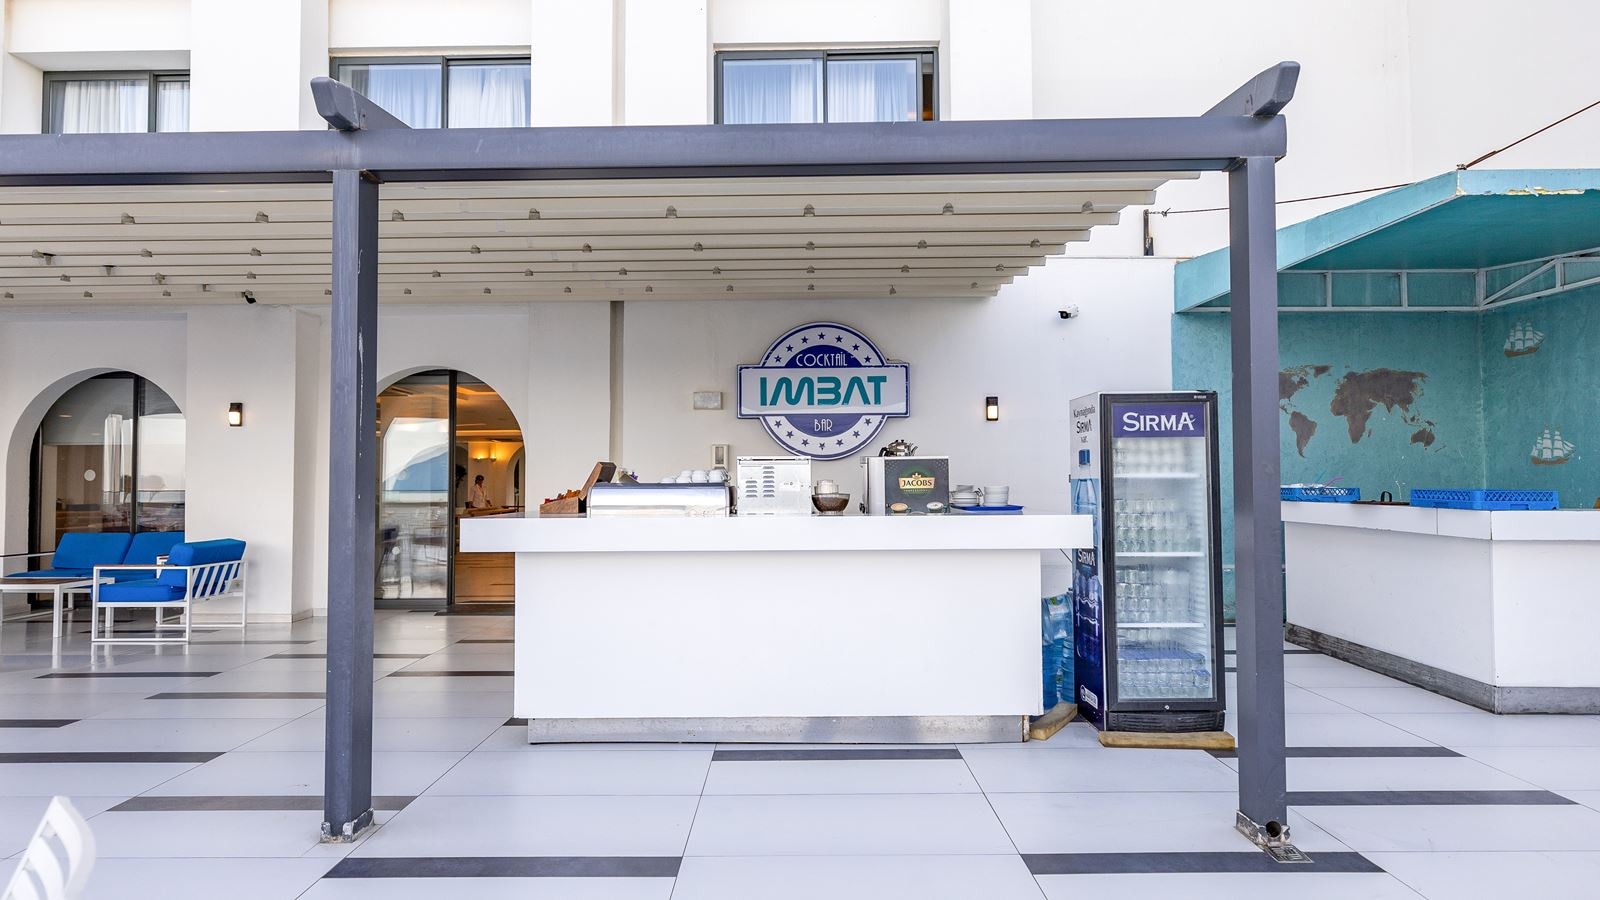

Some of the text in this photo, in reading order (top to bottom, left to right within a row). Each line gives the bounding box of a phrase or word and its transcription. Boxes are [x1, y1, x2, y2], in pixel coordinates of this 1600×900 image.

[759, 375, 888, 407] IMBAT
[814, 418, 834, 432] BAR
[1122, 411, 1196, 432] SIRMA
[902, 479, 933, 487] JACOBS
